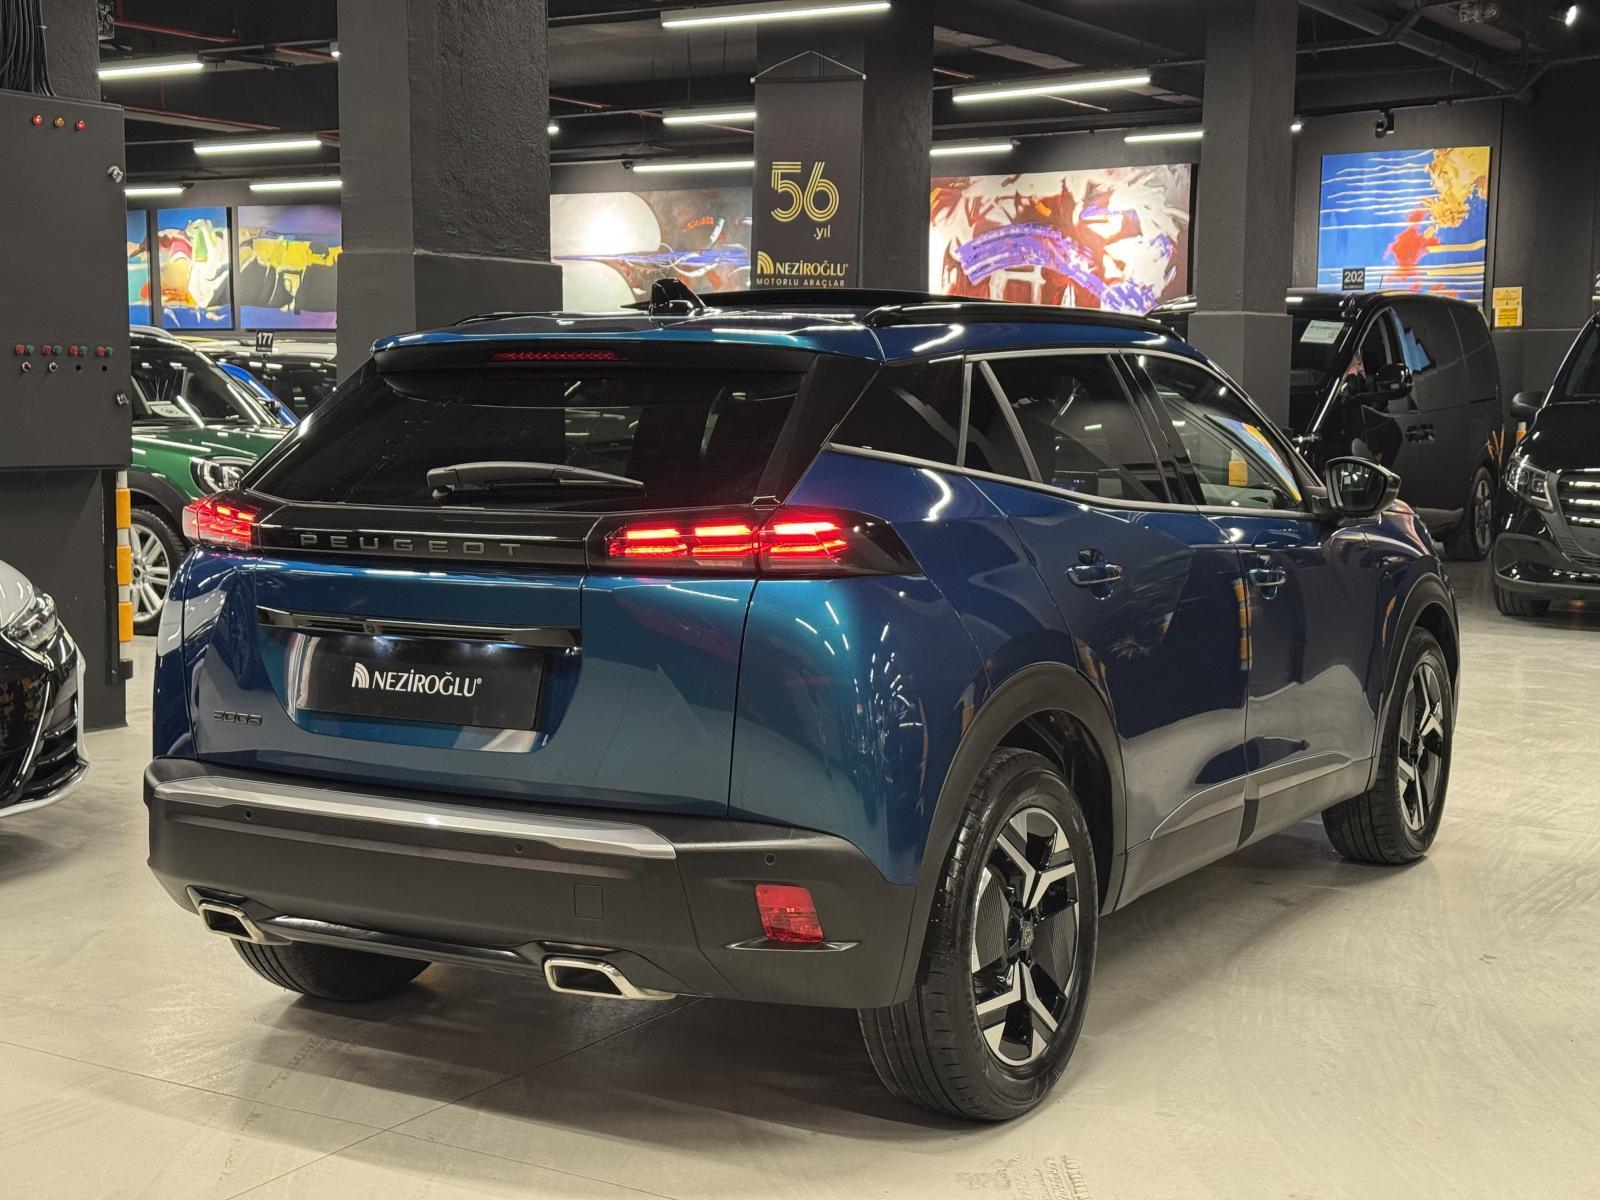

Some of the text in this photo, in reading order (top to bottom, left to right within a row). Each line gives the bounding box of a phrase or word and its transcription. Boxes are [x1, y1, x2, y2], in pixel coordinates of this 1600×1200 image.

[771, 161, 839, 222] 56
[756, 278, 845, 288] MOTORLU ARAÇLAR
[1344, 271, 1364, 282] 202
[257, 332, 273, 345] 177
[300, 533, 521, 556] PEUGEOT
[372, 669, 478, 697] NEZİROĞLU
[213, 710, 263, 726] 2008
